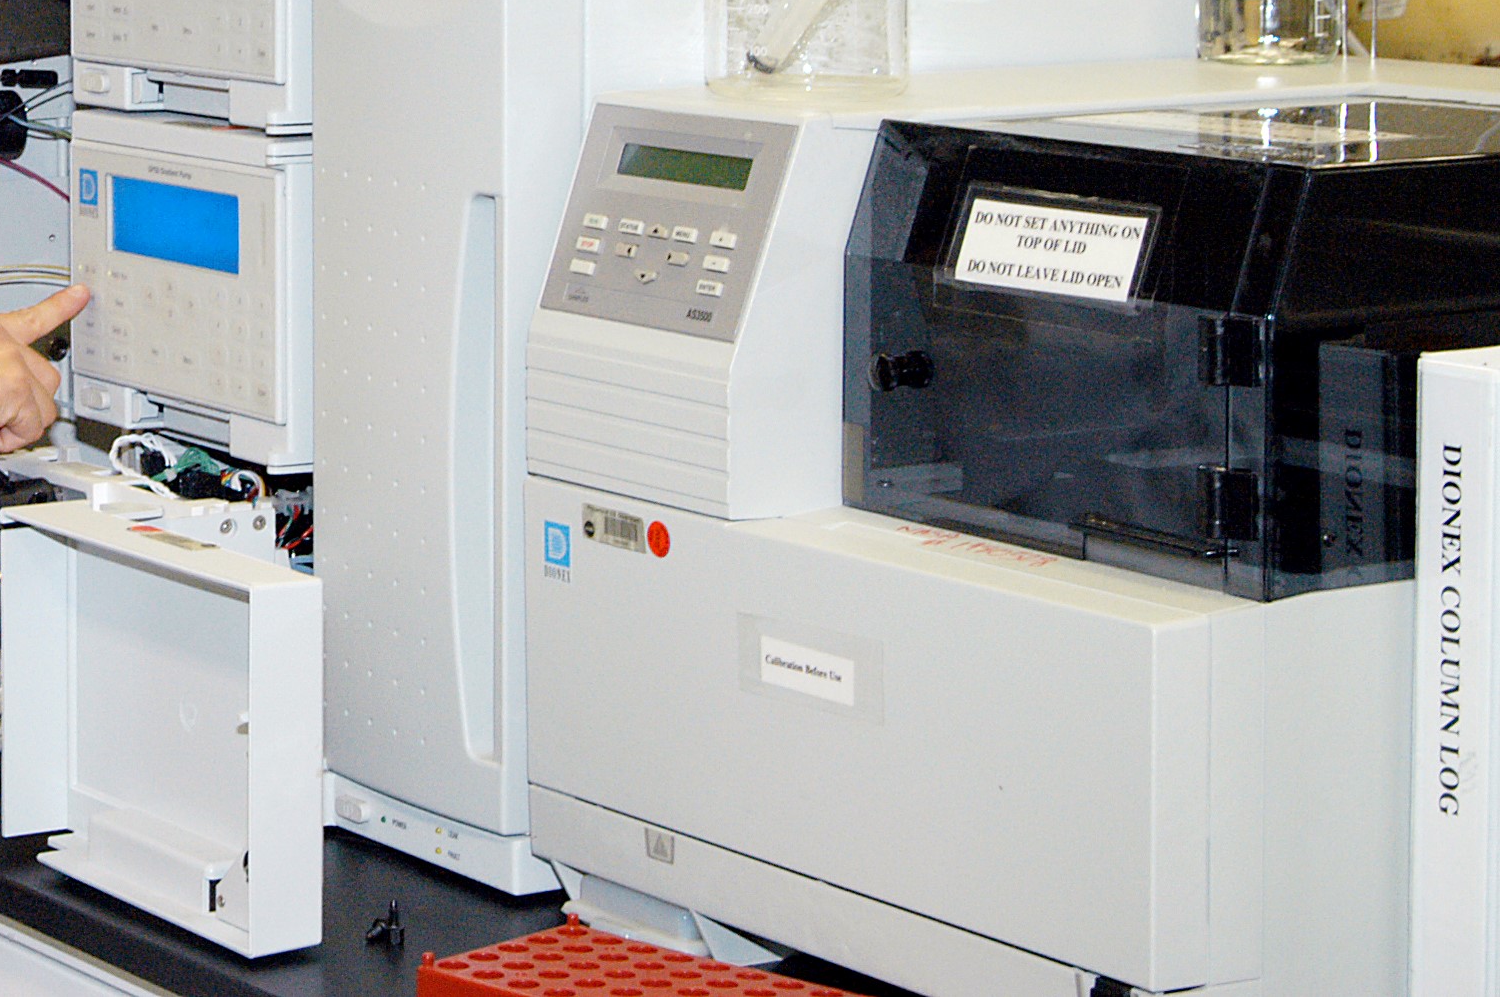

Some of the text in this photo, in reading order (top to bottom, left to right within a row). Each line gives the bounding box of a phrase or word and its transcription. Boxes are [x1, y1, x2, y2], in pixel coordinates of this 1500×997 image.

[974, 210, 1143, 241] DO NOT SET ANYTHING ON
[1016, 234, 1088, 255] TOP OF LID
[967, 259, 1125, 289] DO NOT LEAVE LID OPEN
[1439, 442, 1462, 817] DIONEX COLUMN LOG
[765, 654, 842, 683] Calibration Before Use
